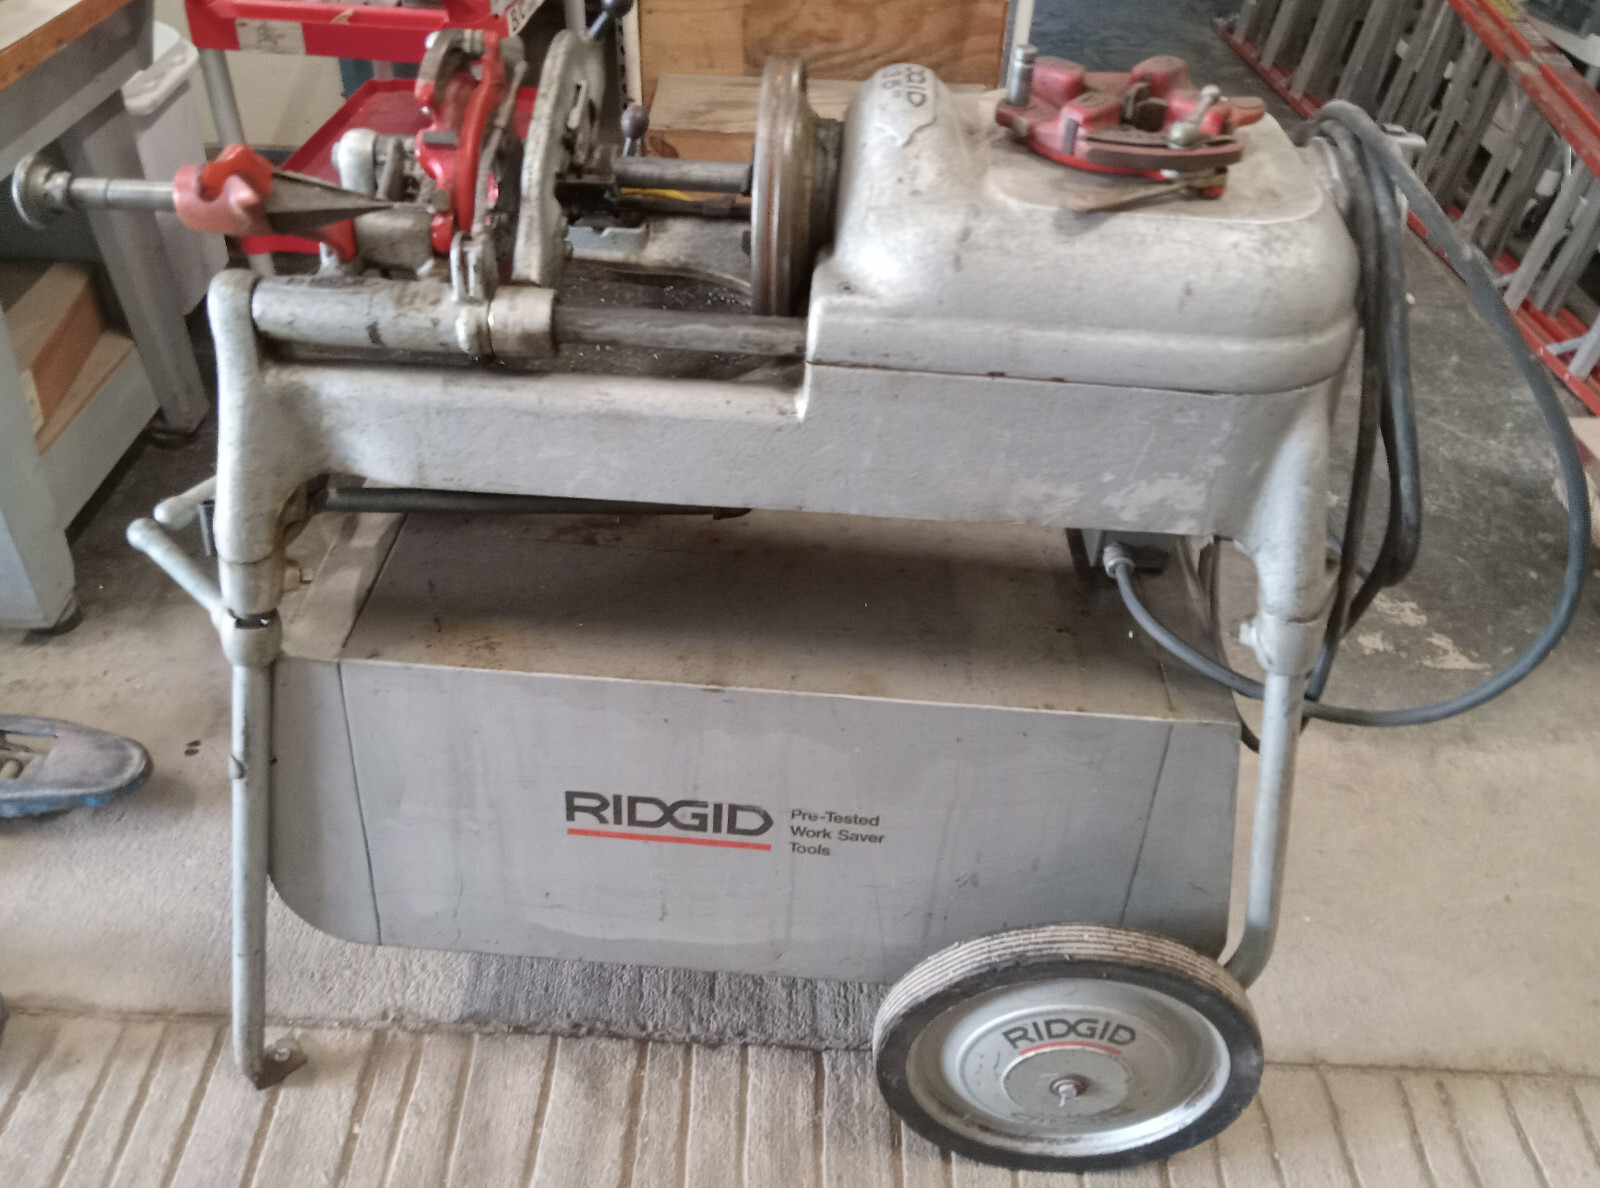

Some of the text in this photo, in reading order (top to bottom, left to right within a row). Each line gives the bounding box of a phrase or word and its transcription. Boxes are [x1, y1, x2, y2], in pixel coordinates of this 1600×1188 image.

[565, 790, 774, 837] RIDGID
[790, 808, 880, 828] Pre-Tested
[790, 826, 886, 845] Work Saver
[790, 842, 831, 857] Tools
[1002, 1018, 1136, 1049] RIDGID
